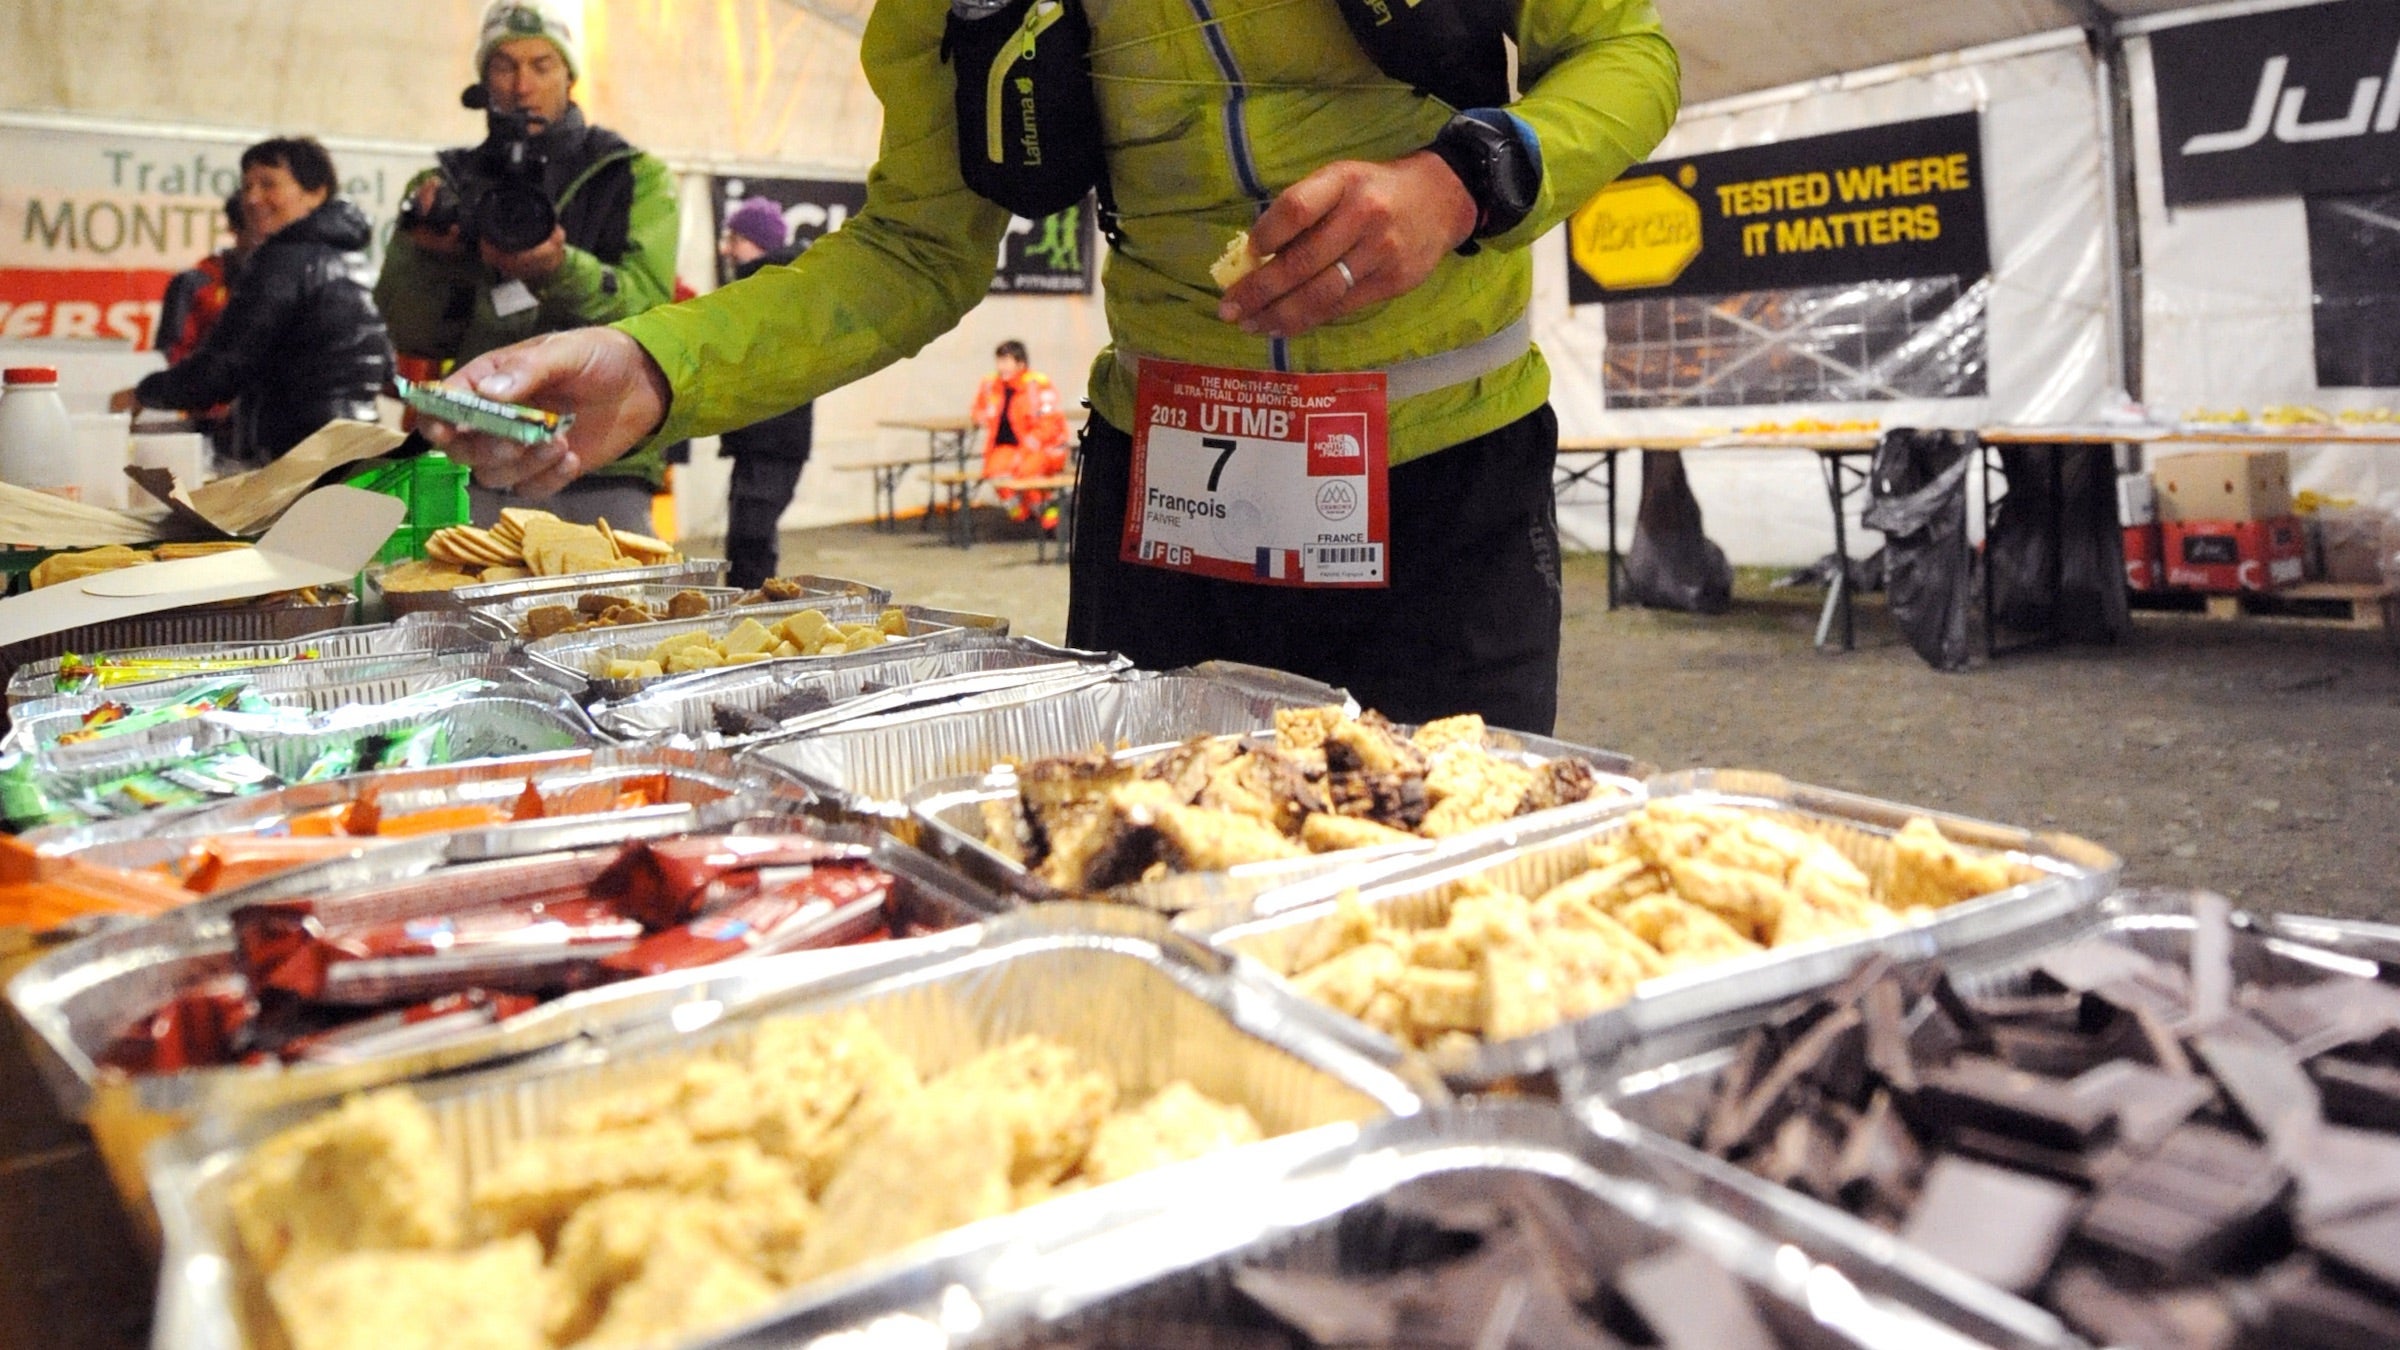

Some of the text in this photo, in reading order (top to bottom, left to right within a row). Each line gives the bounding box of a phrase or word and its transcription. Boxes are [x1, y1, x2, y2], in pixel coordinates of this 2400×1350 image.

[1021, 97, 1041, 166] Lafuma
[1716, 152, 1970, 218] TESTED WHERE
[1742, 203, 1942, 257] IT MATTERS
[1173, 383, 1234, 403] ULTRA-TRAIL
[1237, 391, 1253, 404] DU
[1200, 376, 1221, 389] THE
[1150, 404, 1188, 428] 2013
[1202, 437, 1237, 492] 7
[1148, 488, 1226, 519] François
[1147, 512, 1182, 527] FAIVRE
[1317, 533, 1364, 543] FRANCE
